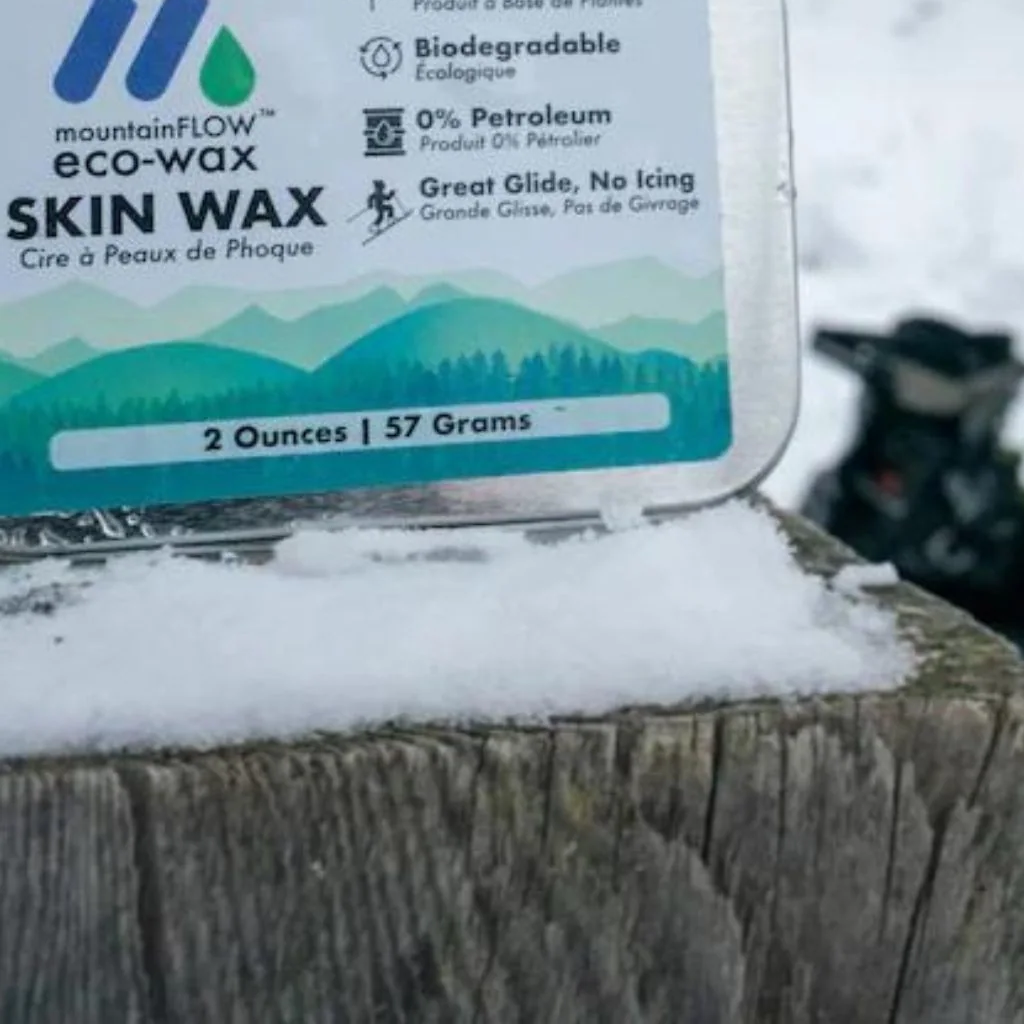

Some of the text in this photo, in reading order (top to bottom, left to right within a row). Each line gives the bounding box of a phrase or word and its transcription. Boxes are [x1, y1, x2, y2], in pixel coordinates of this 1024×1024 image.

[415, 32, 621, 61] Biodegradable
[416, 104, 612, 129] 0% Petroleum
[420, 130, 601, 151] Produit 0% Pétrolier
[53, 145, 258, 178] eco-wax
[419, 167, 695, 198] Great Glide, No Icing
[7, 186, 327, 240] SKIN WAX
[420, 194, 700, 221] Grande Glisse, Pas de Givrage
[20, 237, 314, 269] Cire à Peaux de Phoque
[203, 427, 223, 452] 2
[235, 423, 347, 449] Ounces
[384, 416, 421, 439] 57
[432, 412, 532, 436] Grams
